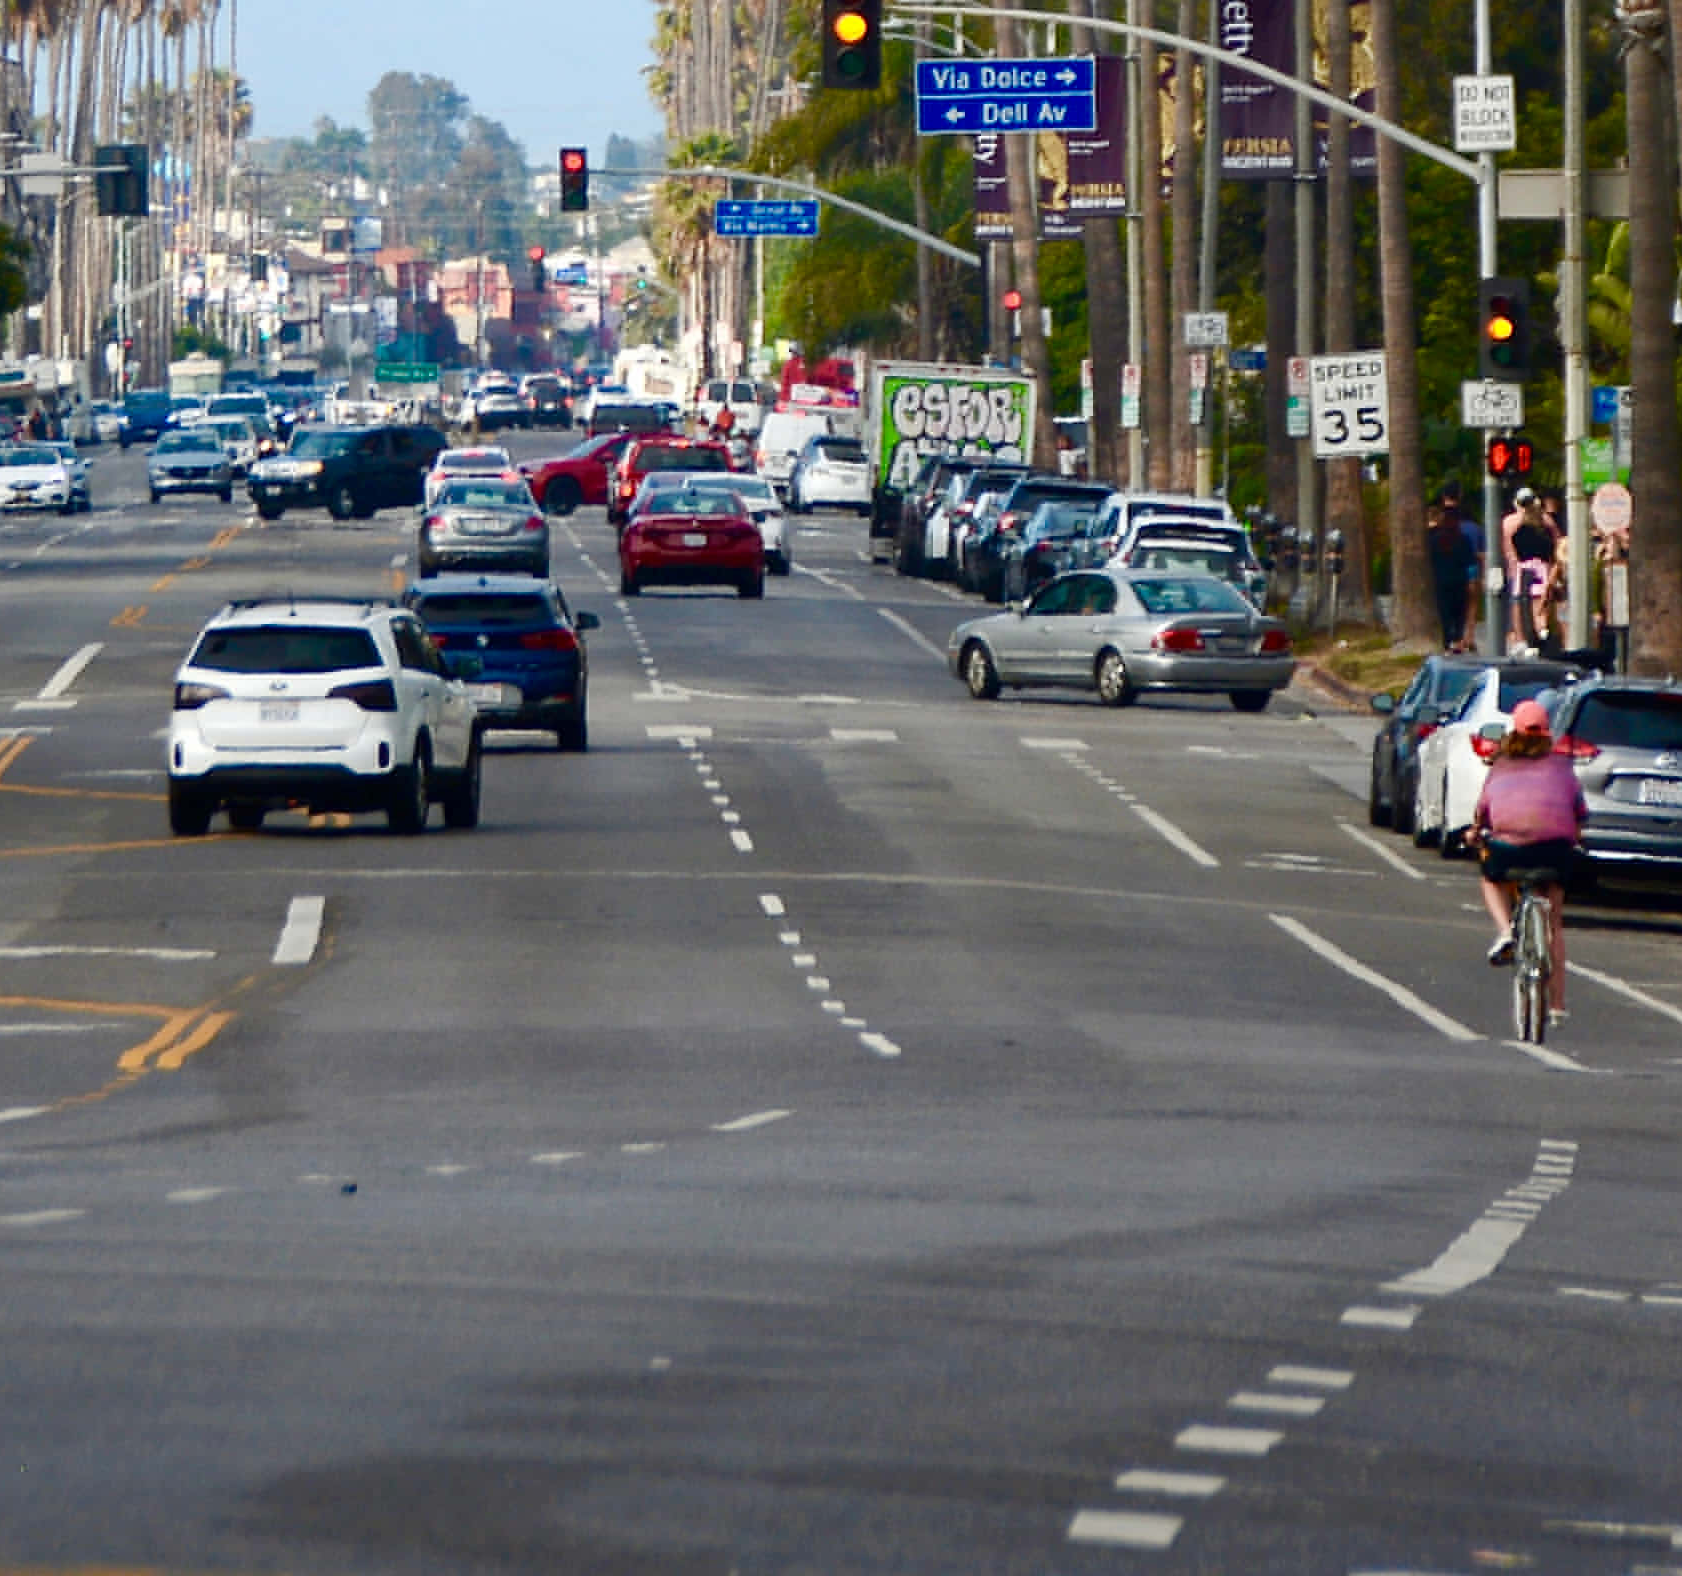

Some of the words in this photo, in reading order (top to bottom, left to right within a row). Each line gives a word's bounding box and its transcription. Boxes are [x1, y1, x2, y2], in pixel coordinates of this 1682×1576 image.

[933, 69, 970, 89] Via
[981, 67, 1048, 88] Dolce
[1460, 85, 1477, 101] DO
[1484, 84, 1511, 101] NOT
[981, 103, 1028, 125] Dell
[1039, 102, 1068, 123] Av
[1459, 109, 1511, 127] BLOCK
[1315, 359, 1383, 381] SPEED
[1324, 384, 1374, 403] LIMIT
[1322, 407, 1385, 445] 35
